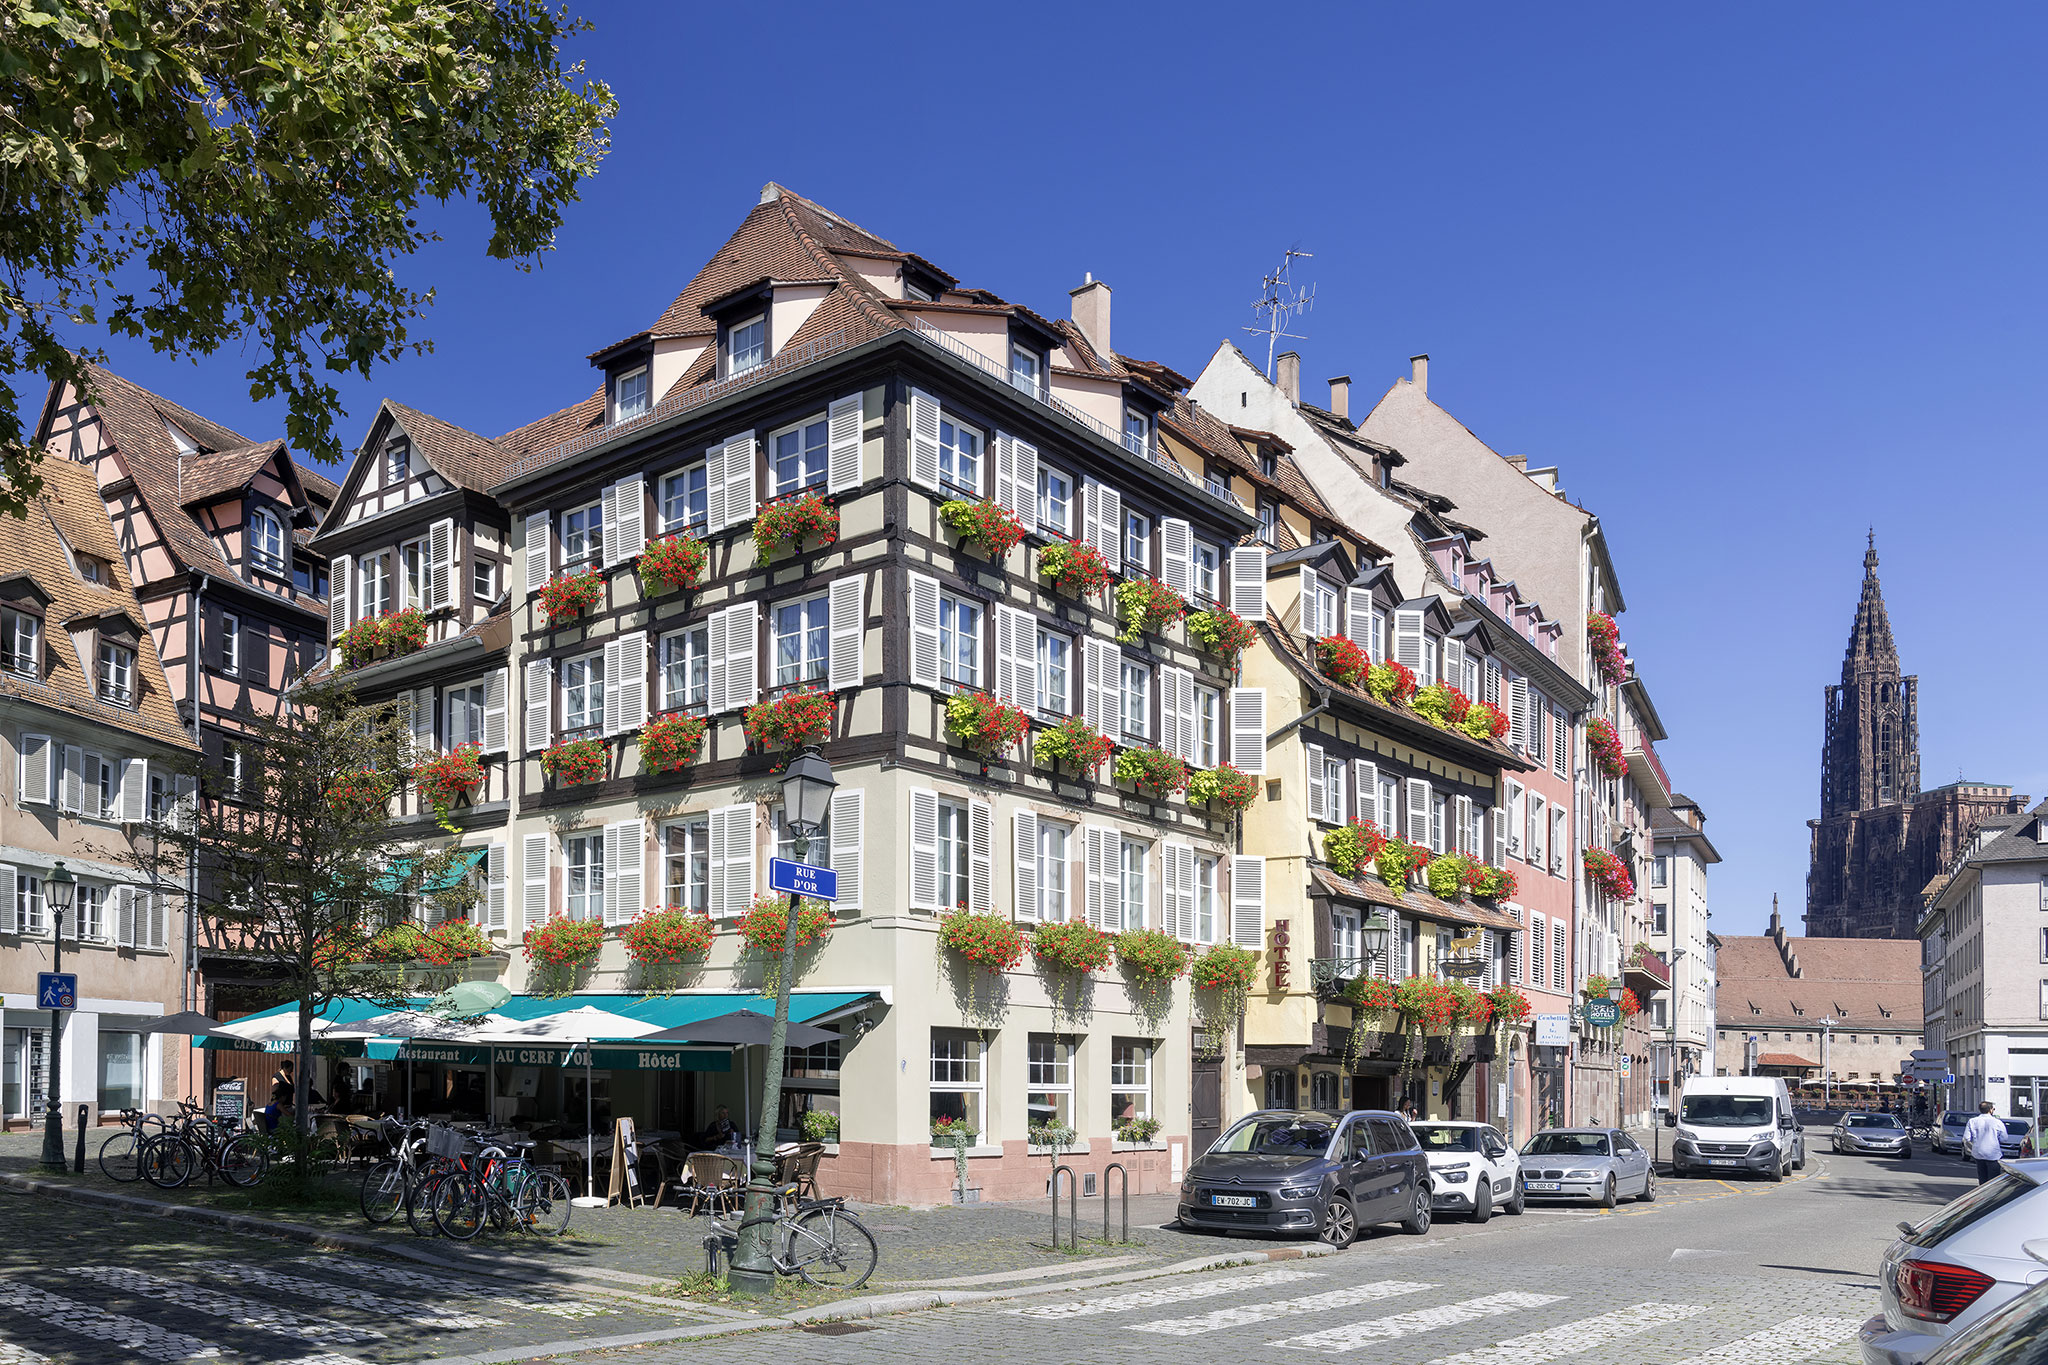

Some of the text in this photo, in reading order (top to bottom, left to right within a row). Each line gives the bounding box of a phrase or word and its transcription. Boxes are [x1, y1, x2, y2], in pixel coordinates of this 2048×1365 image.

[796, 867, 816, 879] RUE
[794, 879, 817, 892] D'OR
[1274, 920, 1290, 986] HOTEL
[399, 1046, 460, 1061] Restaurant
[496, 1049, 515, 1063] AU
[520, 1050, 555, 1064] CERF
[638, 1052, 681, 1068] Hôtel
